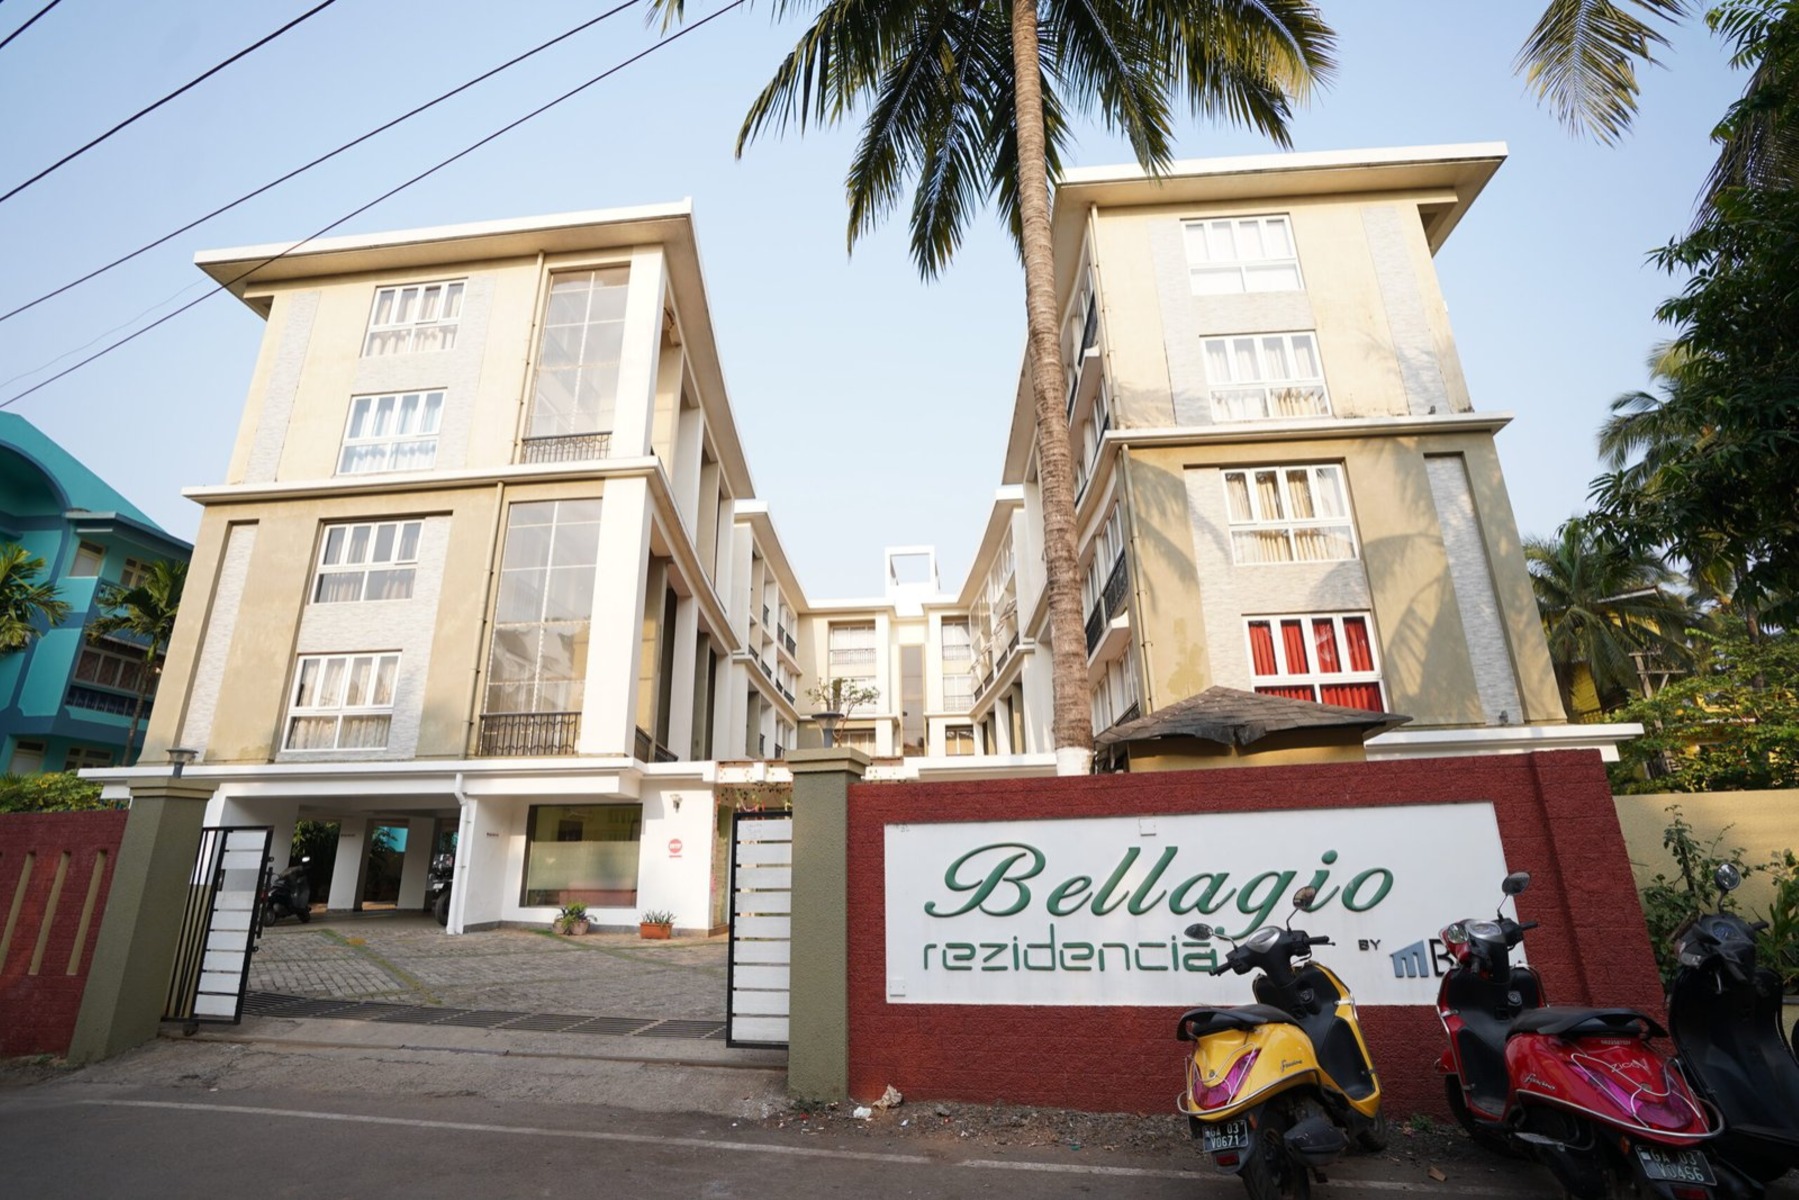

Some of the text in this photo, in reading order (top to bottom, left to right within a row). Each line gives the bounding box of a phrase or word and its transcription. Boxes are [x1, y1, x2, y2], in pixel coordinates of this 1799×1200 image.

[924, 842, 1394, 939] Bellagio
[924, 924, 1217, 973] rezidencia
[1358, 939, 1381, 951] BY
[1226, 1122, 1239, 1134] 03
